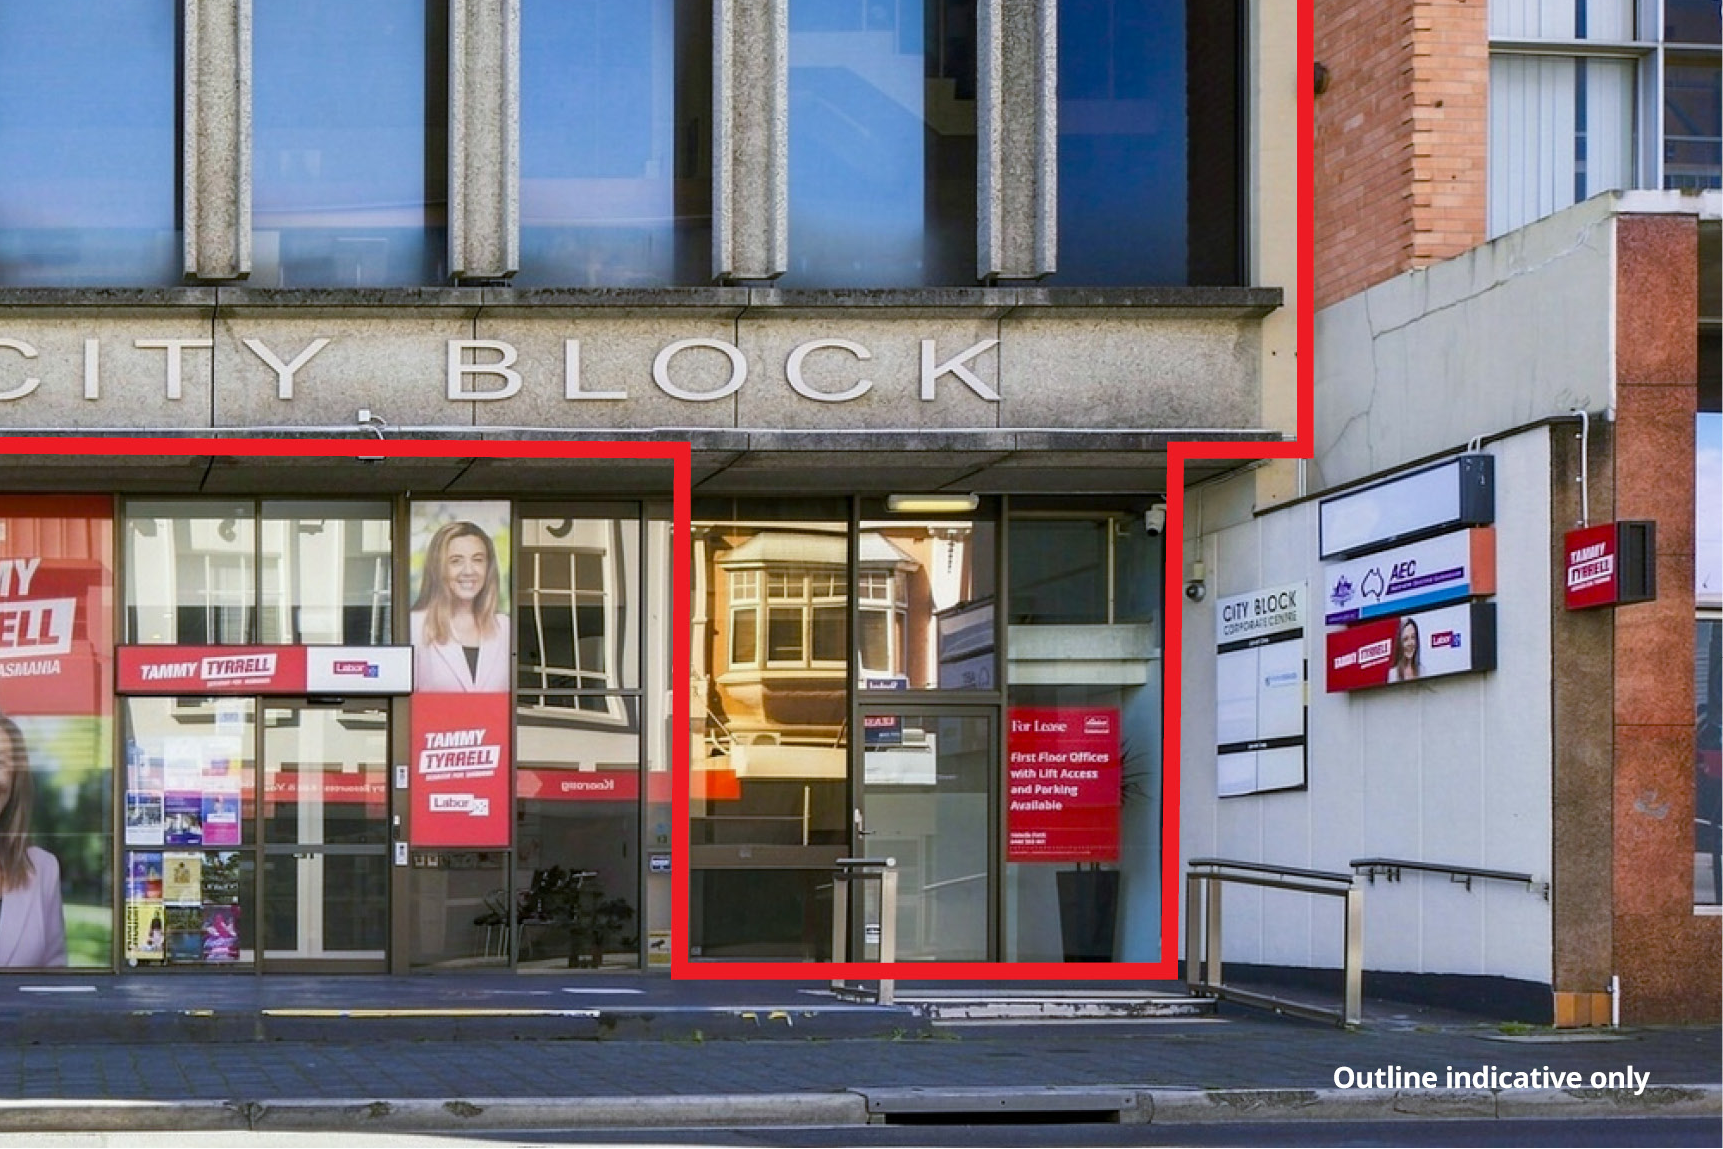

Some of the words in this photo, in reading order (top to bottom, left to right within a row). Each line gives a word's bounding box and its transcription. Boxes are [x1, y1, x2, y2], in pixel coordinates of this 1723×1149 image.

[445, 338, 1001, 403] BLOCK
[1391, 560, 1416, 580] AEC
[1224, 602, 1249, 621] CITY
[1255, 590, 1296, 616] BLOCK
[1224, 617, 1267, 635] CORPORATE
[1269, 611, 1296, 626] CENTRE
[140, 661, 198, 680] TAMMY
[207, 657, 271, 676] TYRRELL
[335, 662, 365, 673] Labor
[1012, 720, 1031, 732] For
[1034, 720, 1068, 732] Lease
[425, 729, 486, 749] TAMMY
[426, 750, 494, 769] TYRRELL
[1011, 752, 1036, 763] First
[1039, 752, 1067, 763] Floor
[1069, 752, 1110, 763] Offices
[1010, 769, 1036, 779] with
[1039, 769, 1058, 779] Lift
[1060, 769, 1099, 779] Access
[1010, 784, 1032, 794] and
[1035, 784, 1078, 797] Parking
[434, 797, 469, 808] Labor
[1010, 800, 1062, 811] Available
